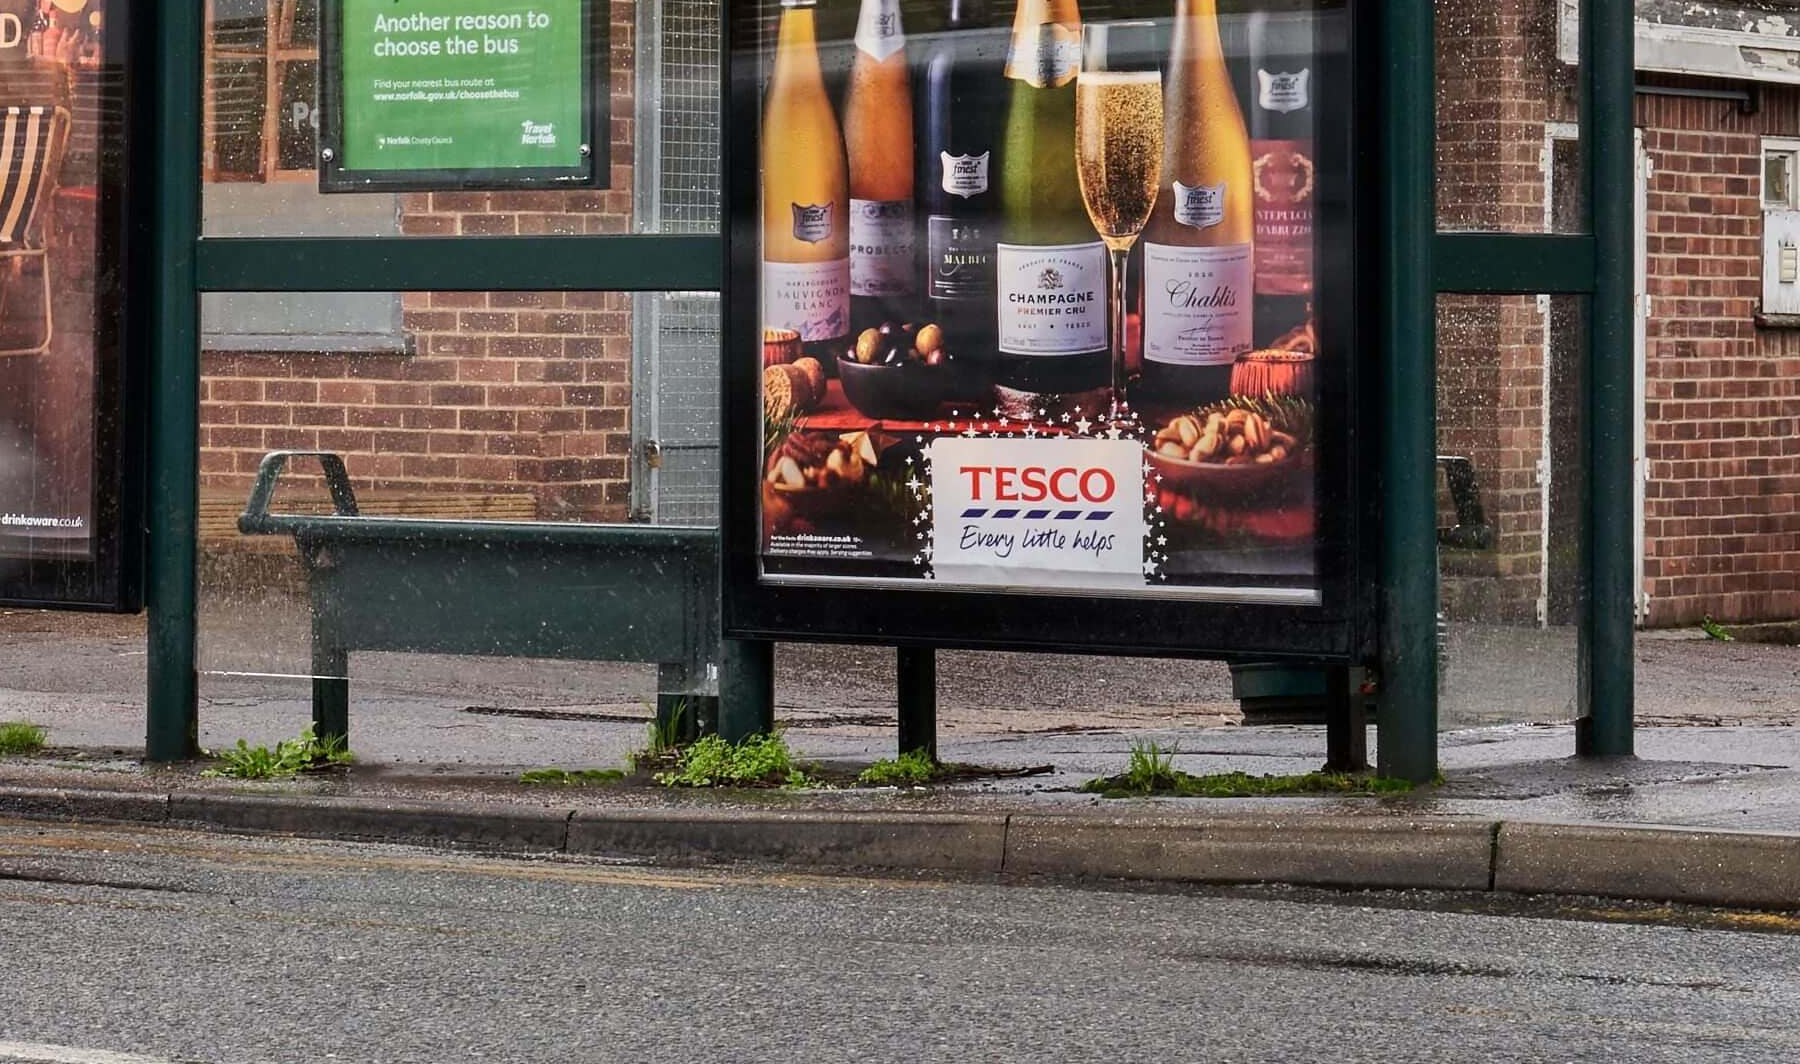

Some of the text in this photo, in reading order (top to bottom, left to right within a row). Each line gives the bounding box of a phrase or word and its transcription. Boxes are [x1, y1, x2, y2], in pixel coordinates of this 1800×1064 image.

[374, 10, 550, 33] Another reason to
[374, 34, 519, 57] choose the bus
[374, 78, 495, 92] Find your nearest bus route at
[373, 89, 520, 102] www.norfolk.gov.uk/choosethebus
[387, 137, 411, 146] Norfolk
[521, 133, 557, 145] Norfolk
[1008, 291, 1095, 305] CHAMPAGNE
[1165, 278, 1236, 309] Chablis
[794, 299, 834, 311] BLANC
[1016, 305, 1086, 316] PREMIER CRU
[960, 467, 1115, 503] TESCO
[960, 524, 1115, 558] Every little helps
